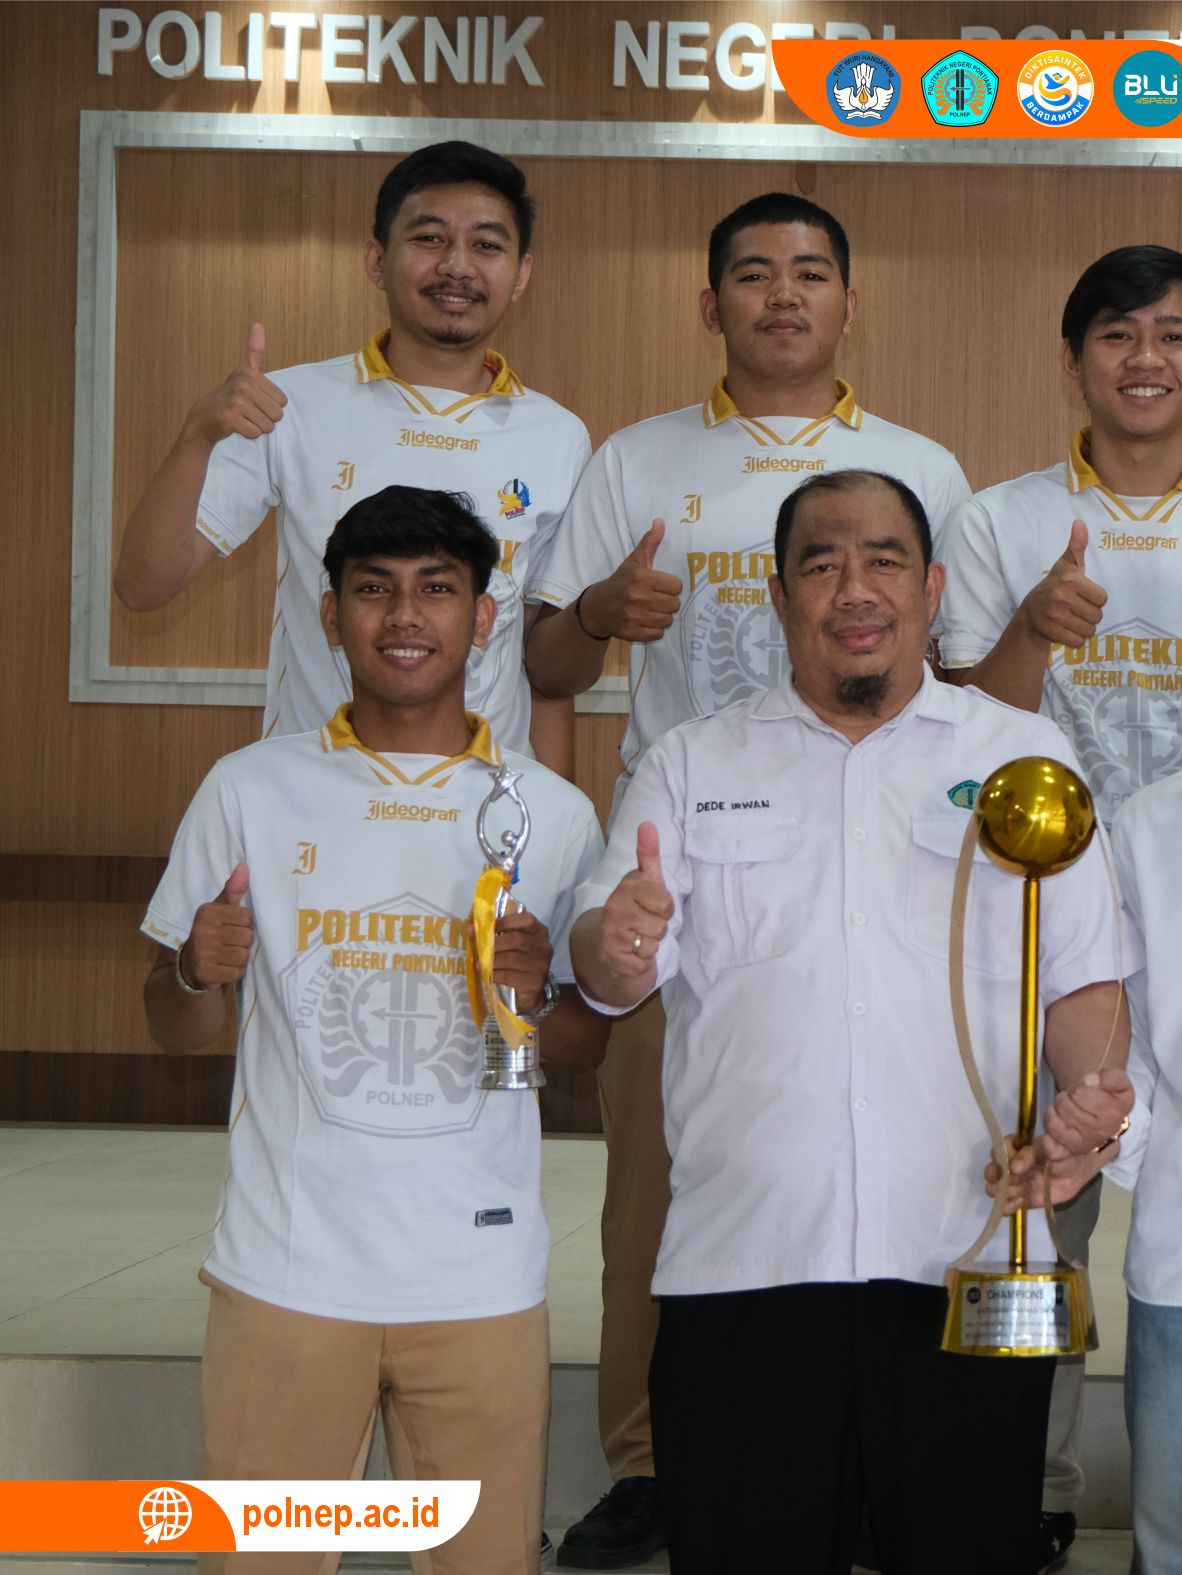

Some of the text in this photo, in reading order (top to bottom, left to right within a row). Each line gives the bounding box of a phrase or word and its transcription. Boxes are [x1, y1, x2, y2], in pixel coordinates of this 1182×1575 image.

[97, 8, 545, 87] POLITEKNIK
[1073, 669, 1122, 688] NEGERI
[696, 800, 770, 813] DEDE IRWAN
[331, 949, 387, 971] NEGERI
[365, 1090, 435, 1107] POLNEP
[986, 1288, 1045, 1300] CHAMPIONS
